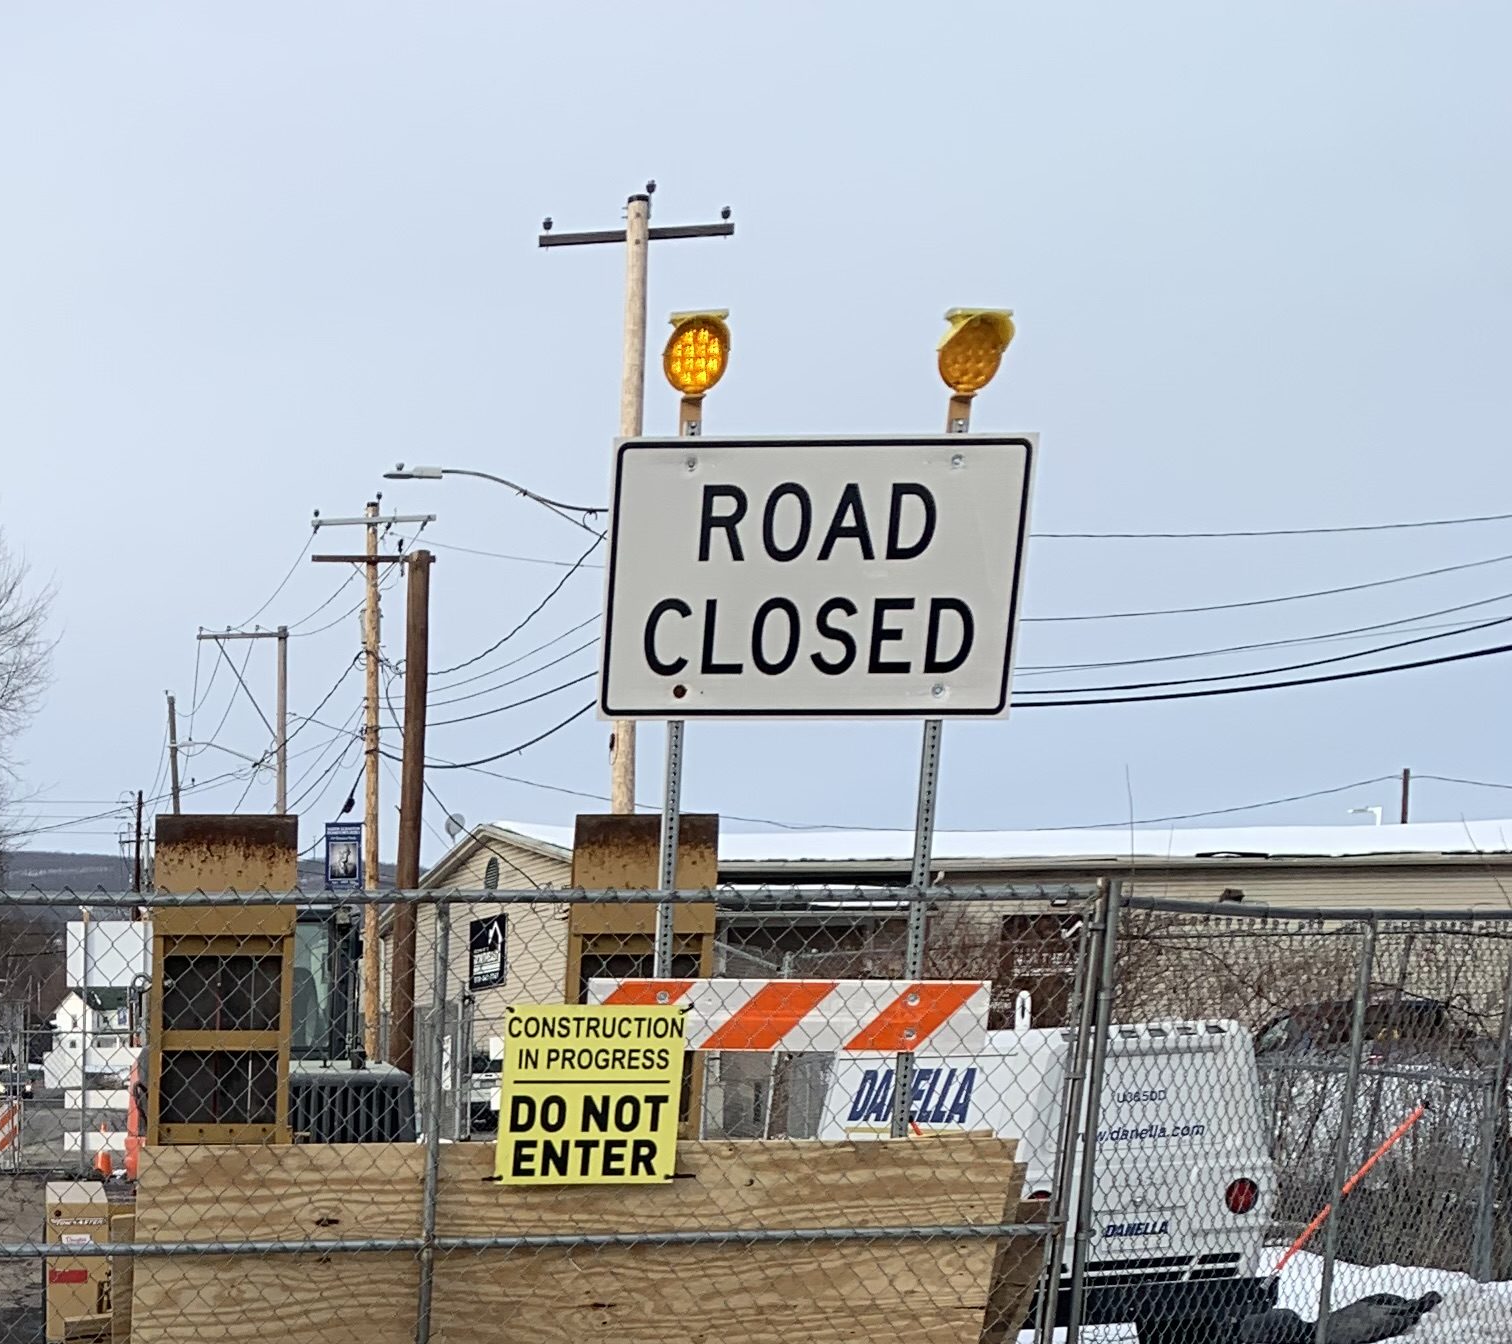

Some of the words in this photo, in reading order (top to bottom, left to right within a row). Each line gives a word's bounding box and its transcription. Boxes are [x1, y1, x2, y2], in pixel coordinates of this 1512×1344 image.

[698, 482, 937, 562] ROAD
[644, 597, 974, 675] CLOSED
[508, 1016, 685, 1038] CONSTRUCTION
[518, 1048, 539, 1070] IN
[546, 1048, 670, 1070] PROGRESS
[509, 1095, 567, 1133] DO
[581, 1095, 669, 1133] NOT
[847, 1067, 977, 1123] DAELLA
[511, 1139, 657, 1177] ENTER
[1104, 1220, 1169, 1238] DANELLA
